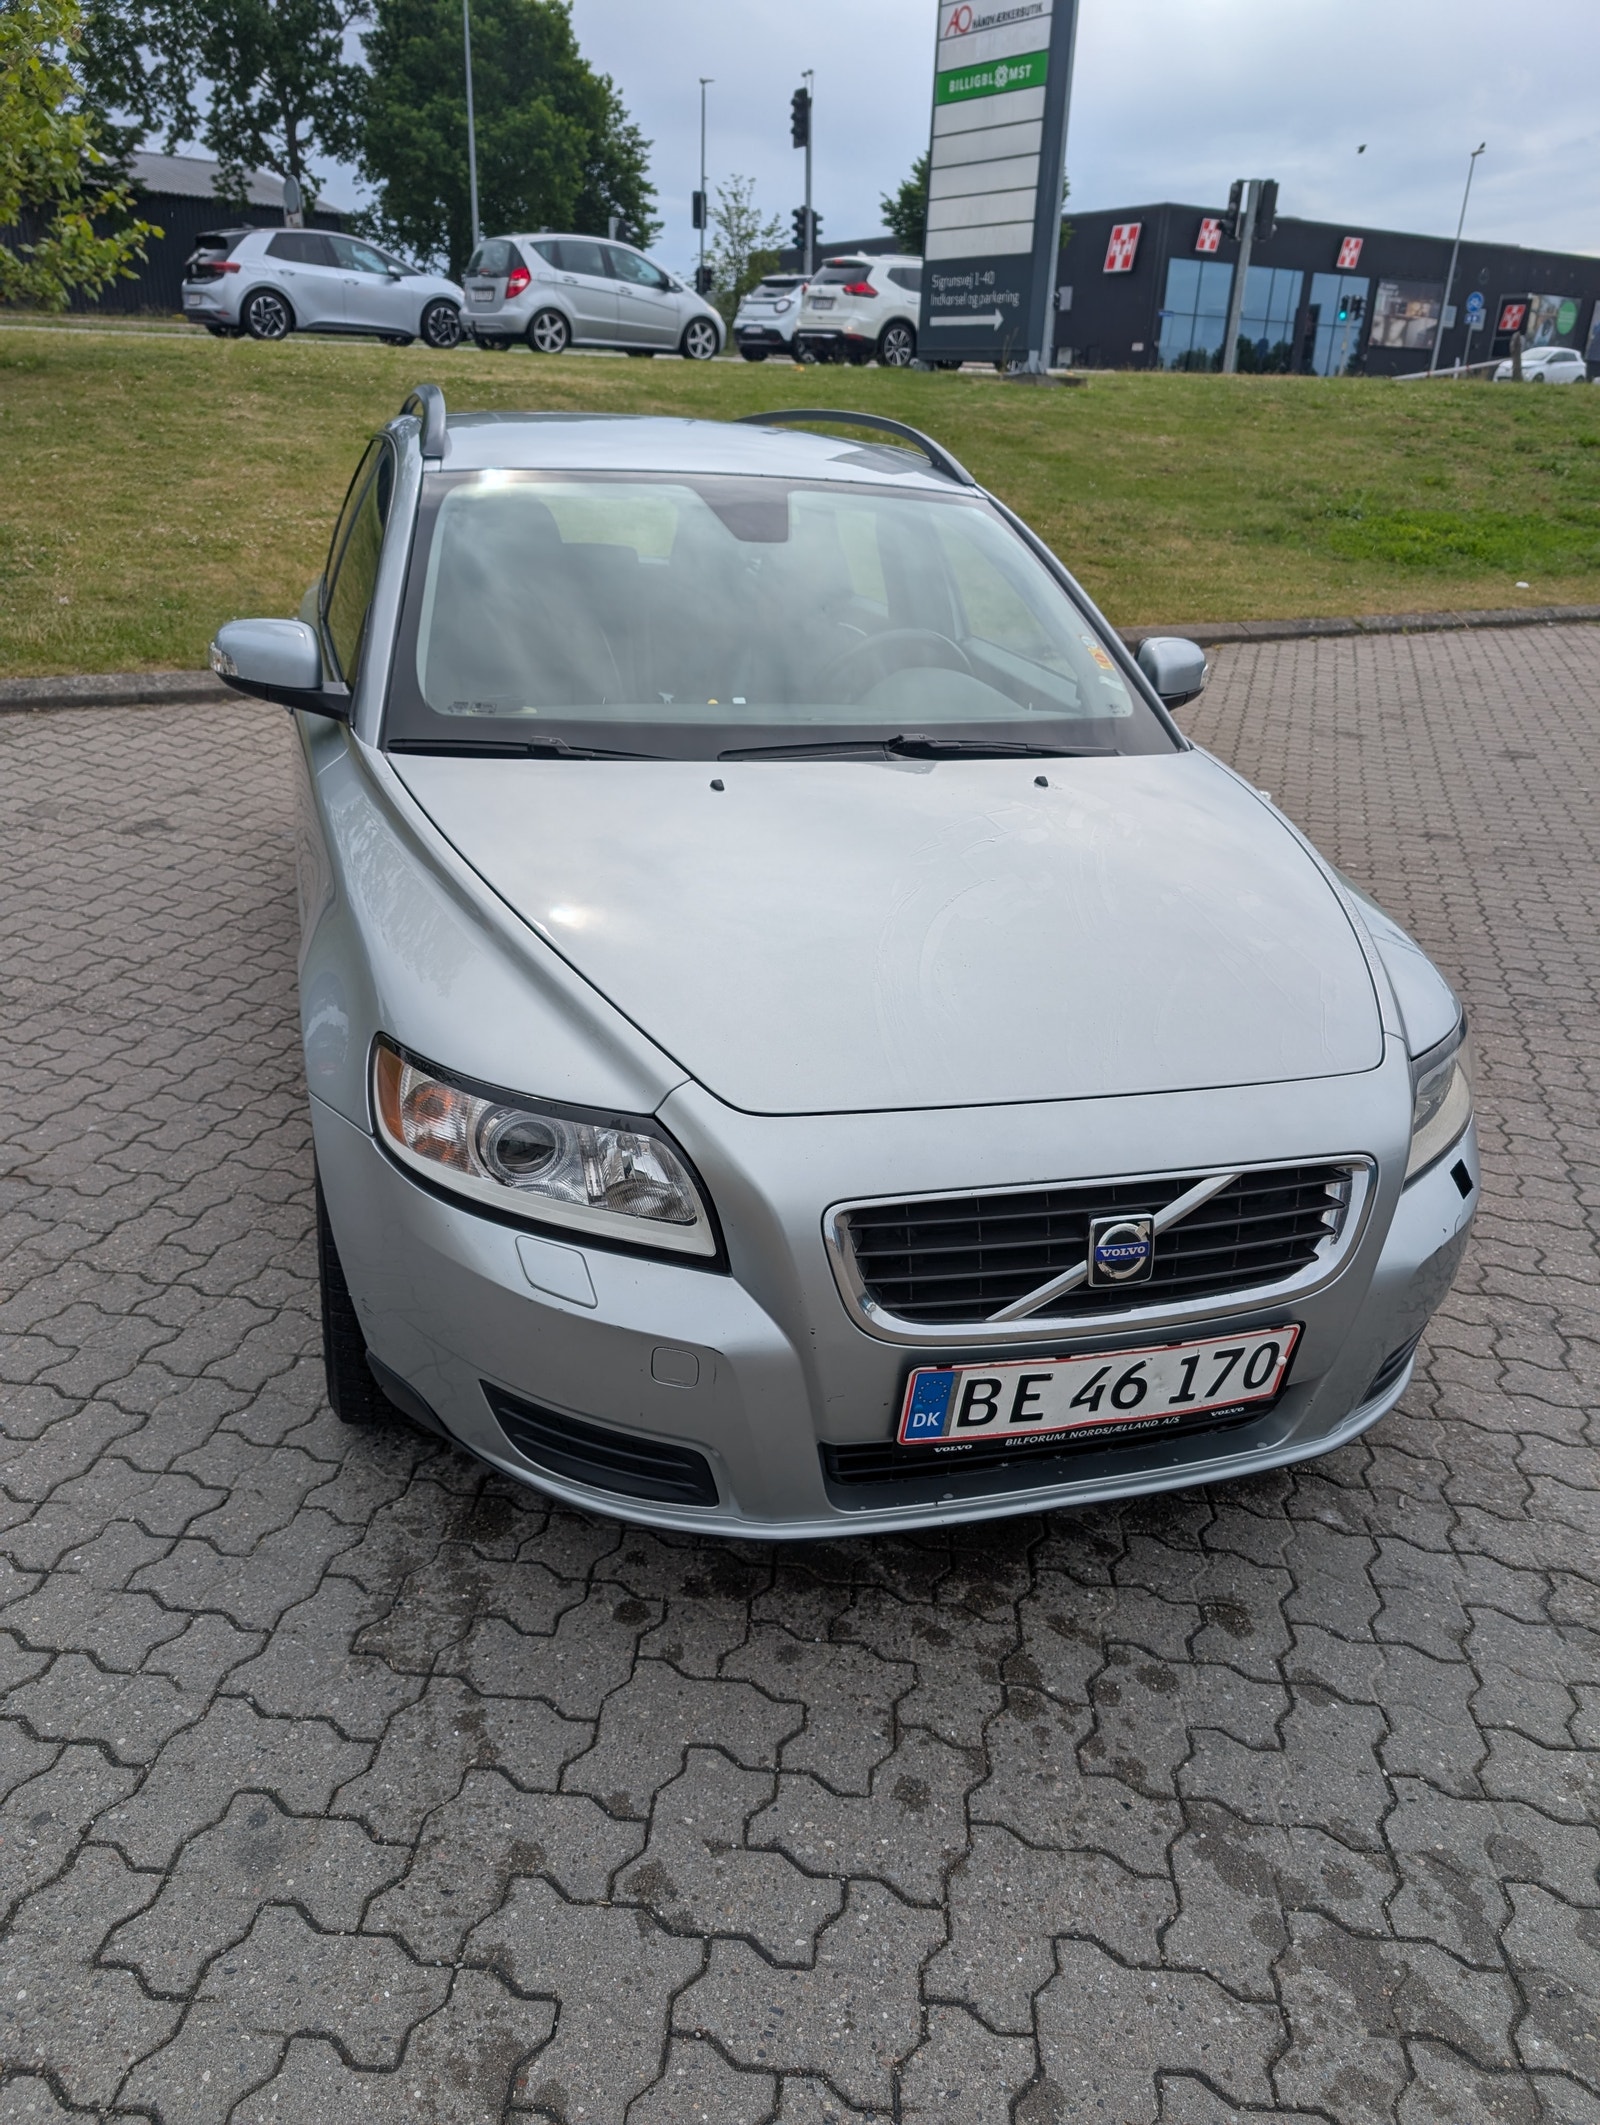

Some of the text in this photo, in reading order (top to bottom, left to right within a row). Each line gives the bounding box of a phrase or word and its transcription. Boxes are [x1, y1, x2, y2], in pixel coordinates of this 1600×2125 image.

[931, 273, 973, 291] Sigrunsvej
[979, 289, 1020, 308] parkering
[1100, 1246, 1145, 1257] VOLVO
[956, 1341, 1280, 1428] BE 46 170
[911, 1411, 942, 1428] DK
[1210, 1406, 1245, 1417] VOLVO
[1004, 1415, 1181, 1447] BILFORUM NORDSJÆLLAND A/S
[933, 1443, 974, 1454] VOLVO
